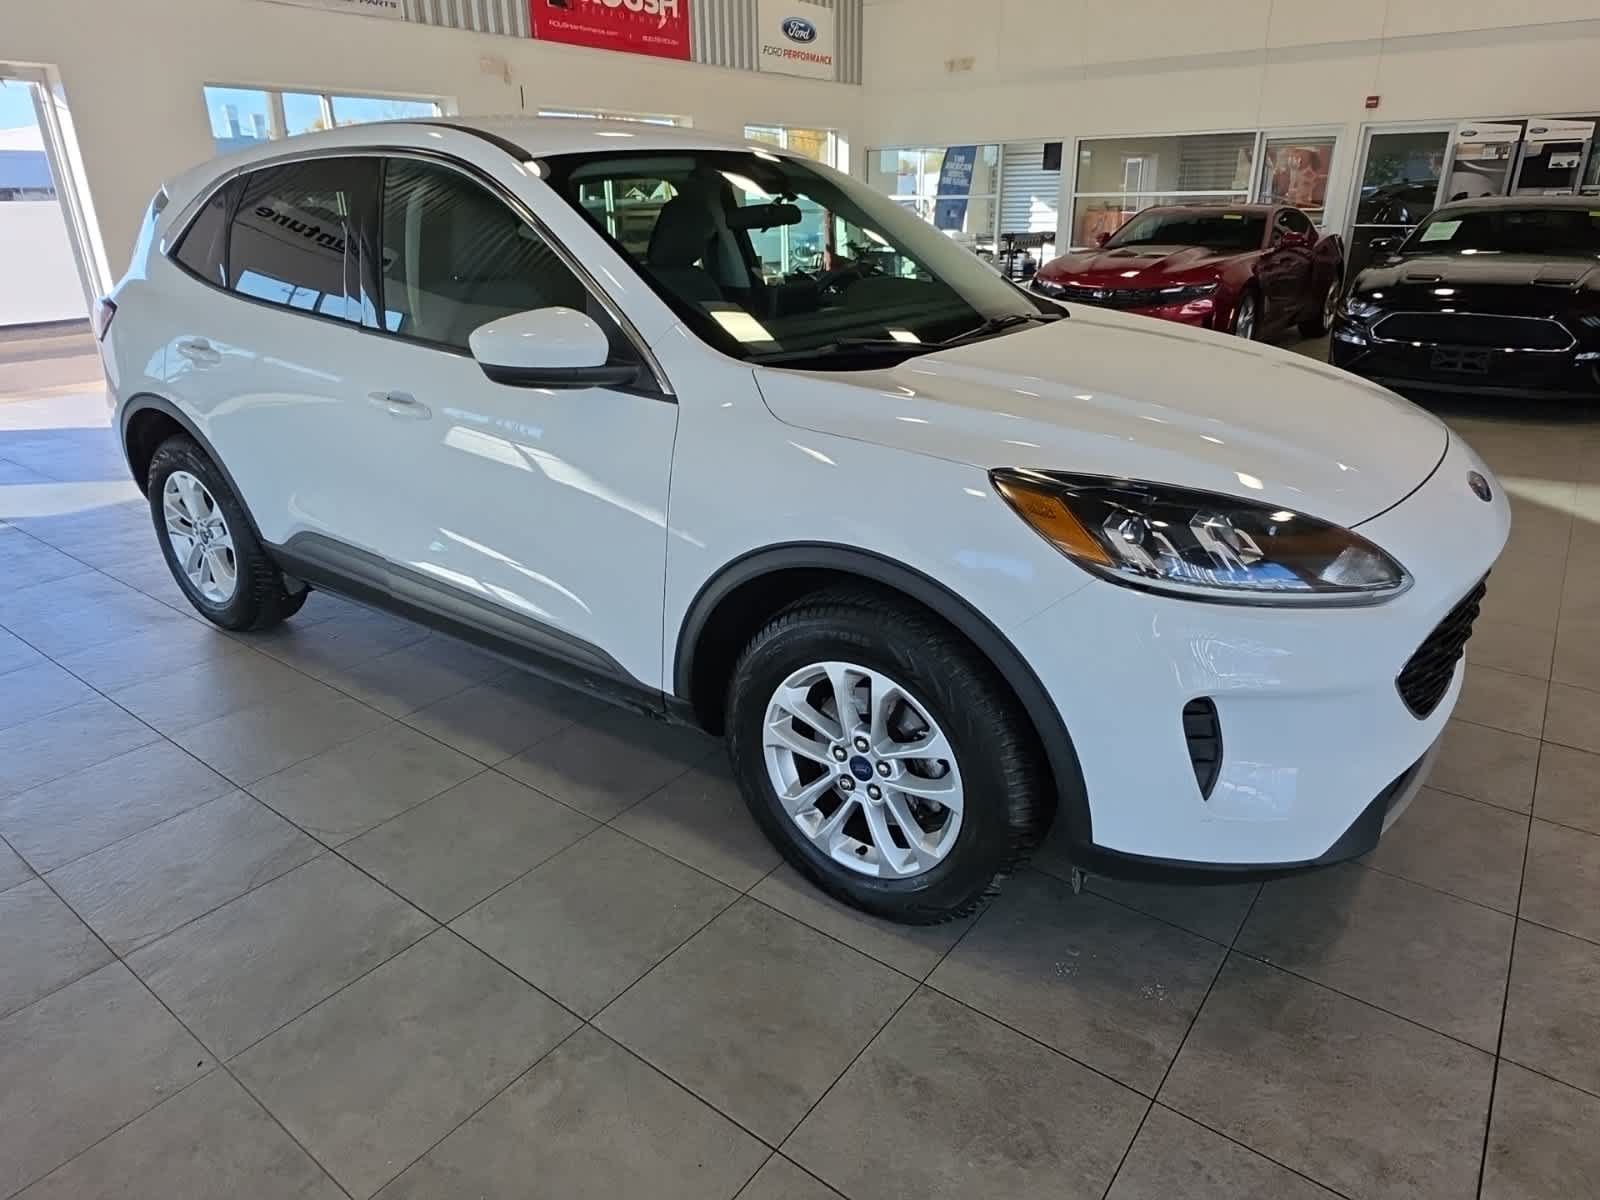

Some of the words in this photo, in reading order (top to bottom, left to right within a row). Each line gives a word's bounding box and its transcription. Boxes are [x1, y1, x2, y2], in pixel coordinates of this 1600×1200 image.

[788, 20, 812, 39] Ford
[762, 45, 782, 57] FORD
[783, 48, 832, 65] PERFORMANCE
